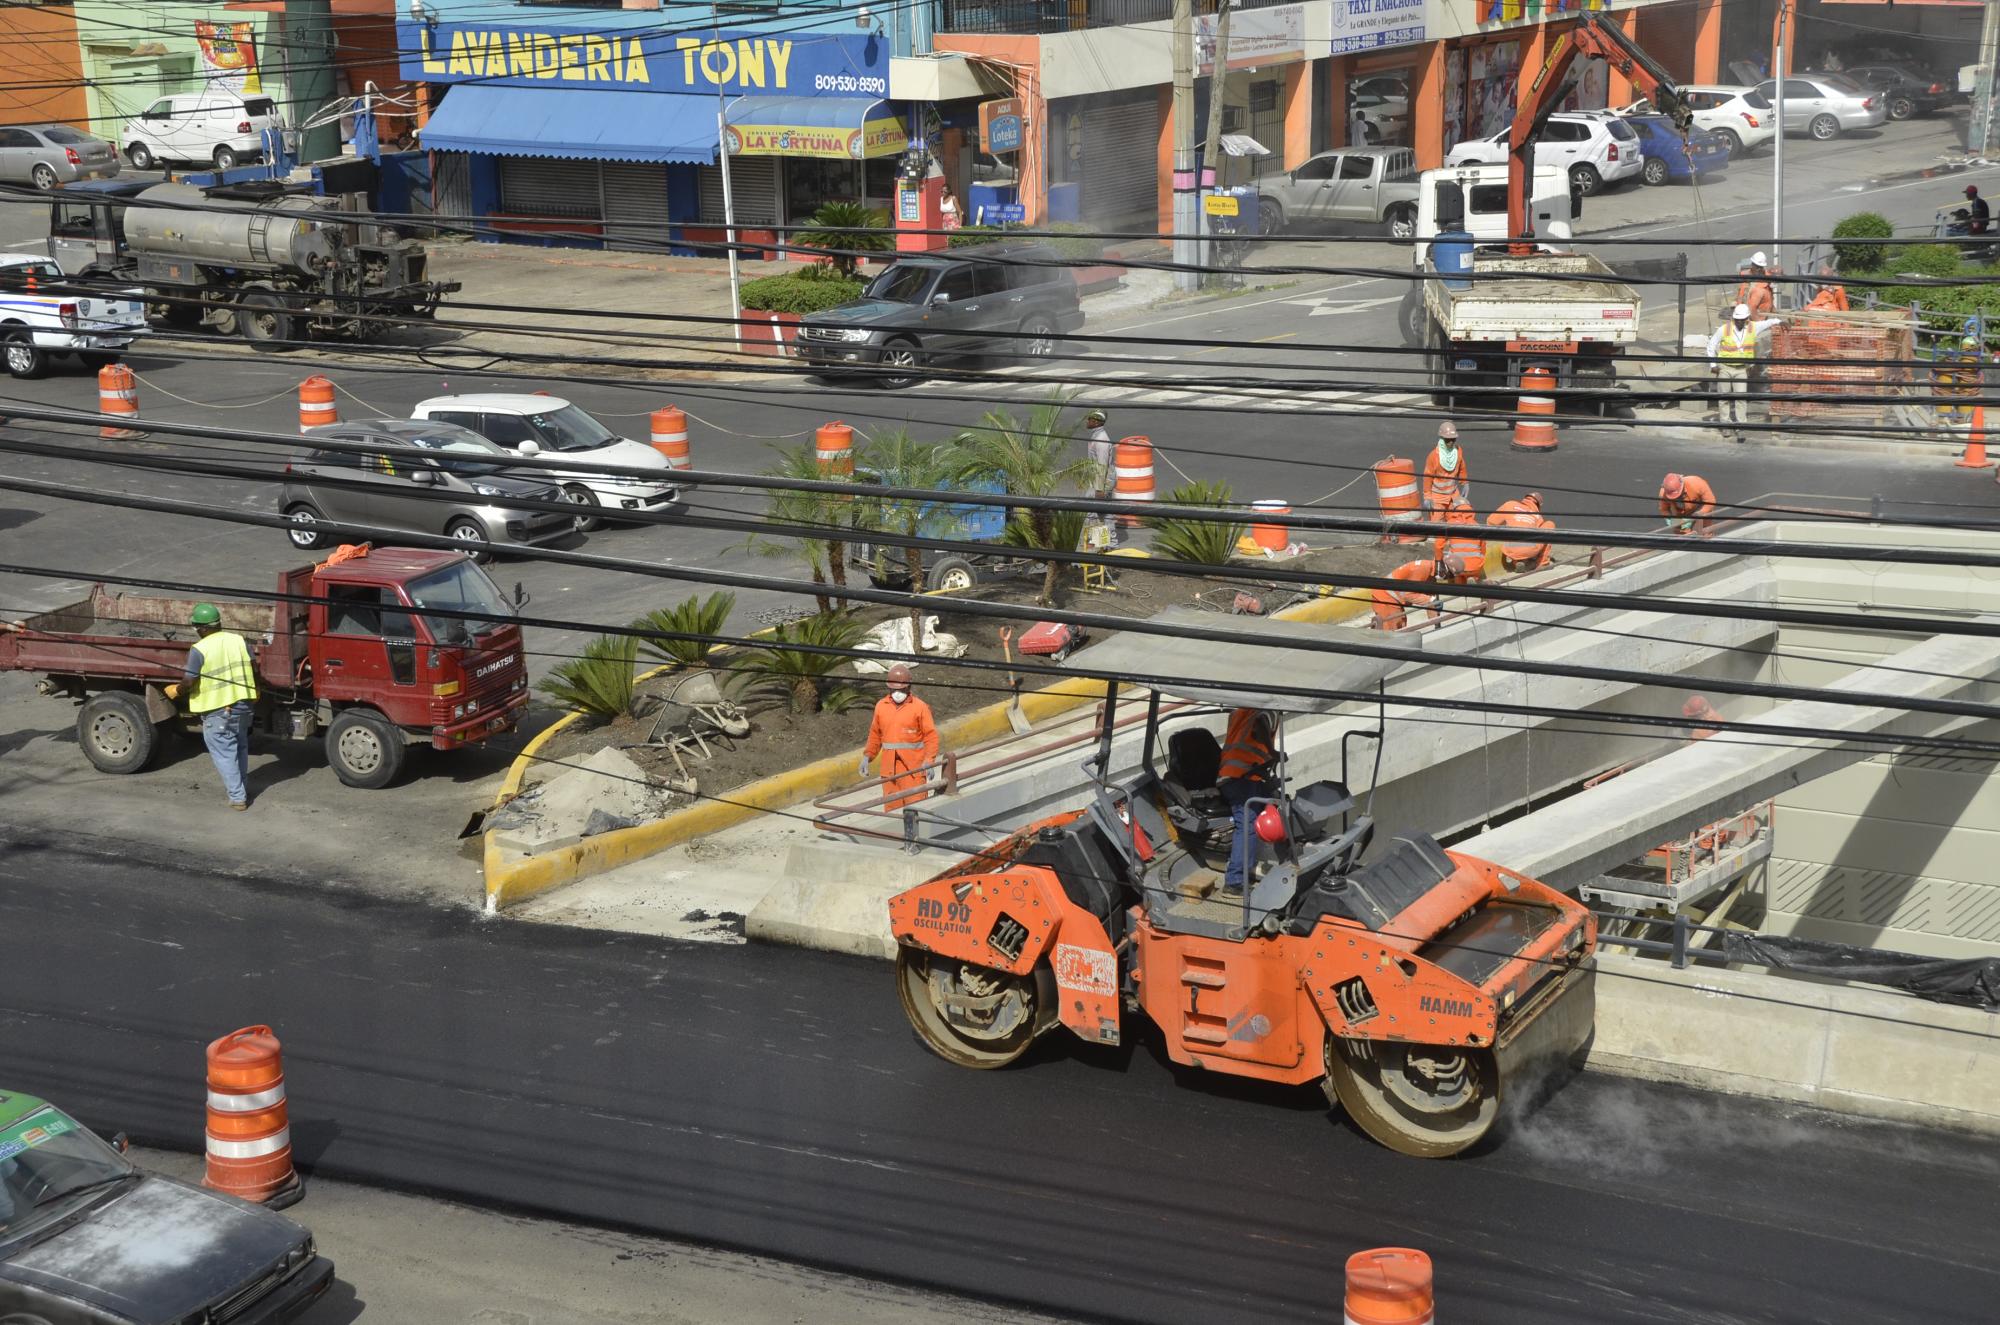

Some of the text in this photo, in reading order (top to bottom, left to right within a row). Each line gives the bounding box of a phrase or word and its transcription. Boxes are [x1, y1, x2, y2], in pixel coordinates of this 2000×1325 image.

[1348, 0, 1371, 15] TAXI
[420, 28, 650, 84] LAVANDERIA
[676, 37, 793, 89] TONY
[745, 136, 764, 148] LA
[992, 127, 1017, 143] Loteka
[476, 654, 514, 678] DAIHATSU
[917, 897, 971, 923] HD 90
[913, 917, 973, 935] OSCILLATION
[1419, 995, 1473, 1018] HAMM
